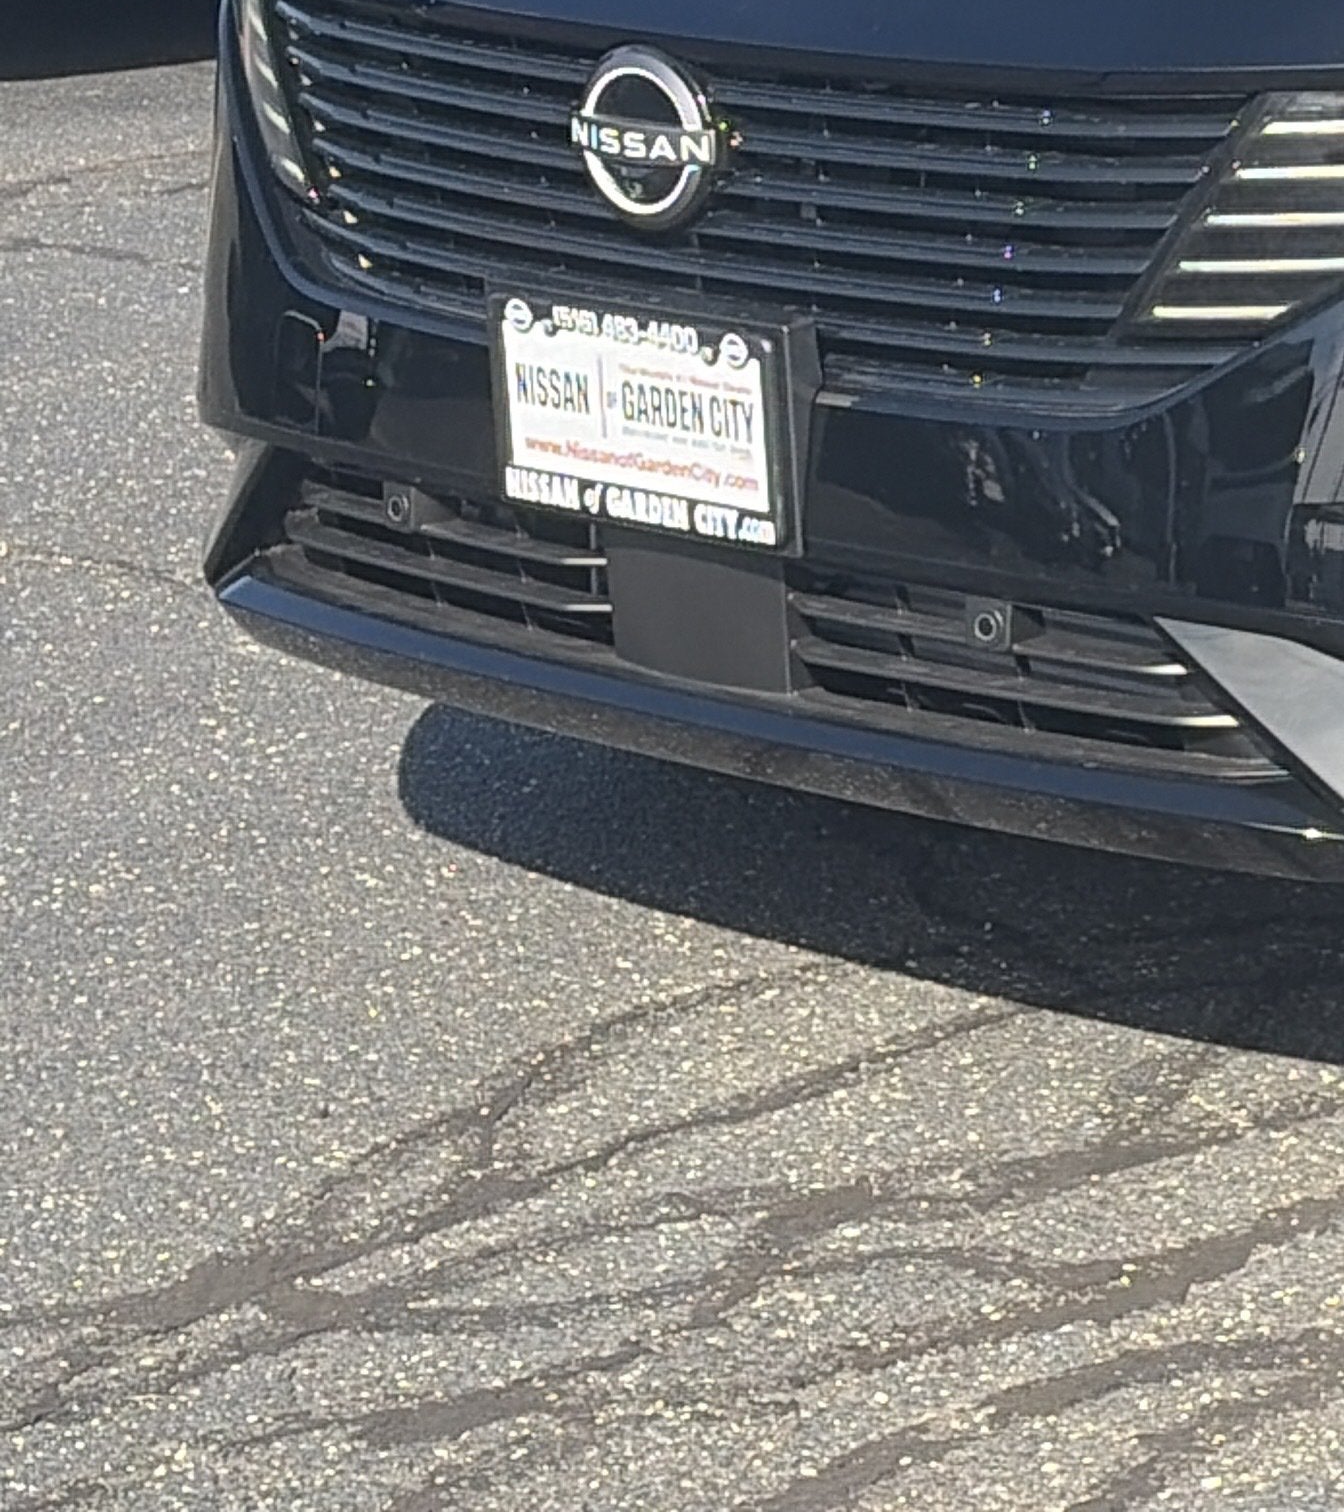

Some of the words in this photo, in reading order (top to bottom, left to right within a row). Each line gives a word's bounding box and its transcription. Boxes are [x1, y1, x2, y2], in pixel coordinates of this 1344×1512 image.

[571, 115, 711, 163] NISSAN
[515, 360, 591, 416] NISSAN
[621, 379, 705, 435] GARDEN
[709, 394, 754, 444] CITY
[504, 465, 581, 510] NISSAN
[606, 485, 691, 532] GARDEN
